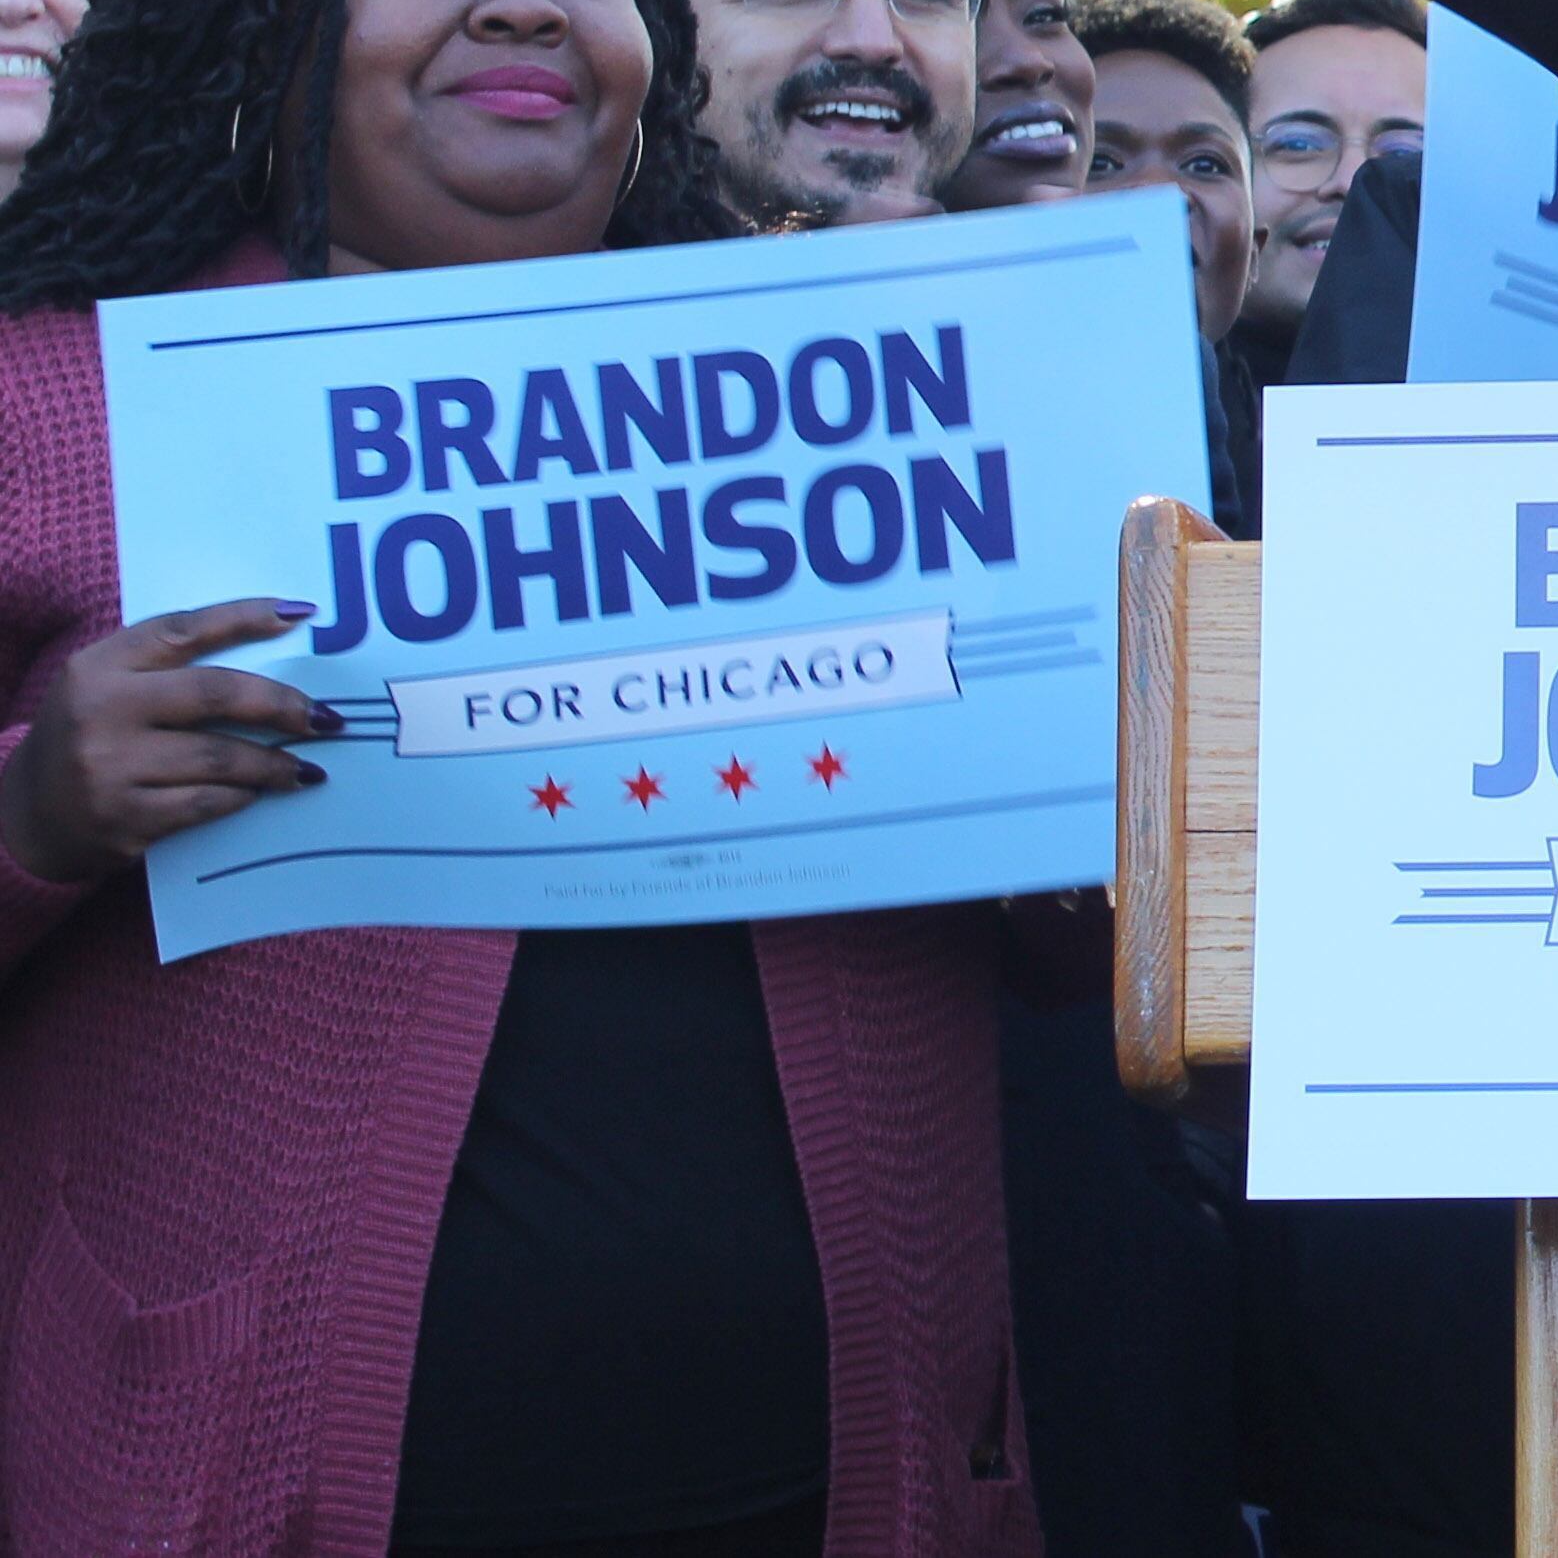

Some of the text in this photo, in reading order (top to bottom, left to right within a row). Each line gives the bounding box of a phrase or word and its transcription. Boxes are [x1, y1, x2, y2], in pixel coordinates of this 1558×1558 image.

[327, 321, 972, 501] BRANDON
[311, 447, 1016, 654] JOHNSON
[465, 641, 896, 731] FOR CHICAGO
